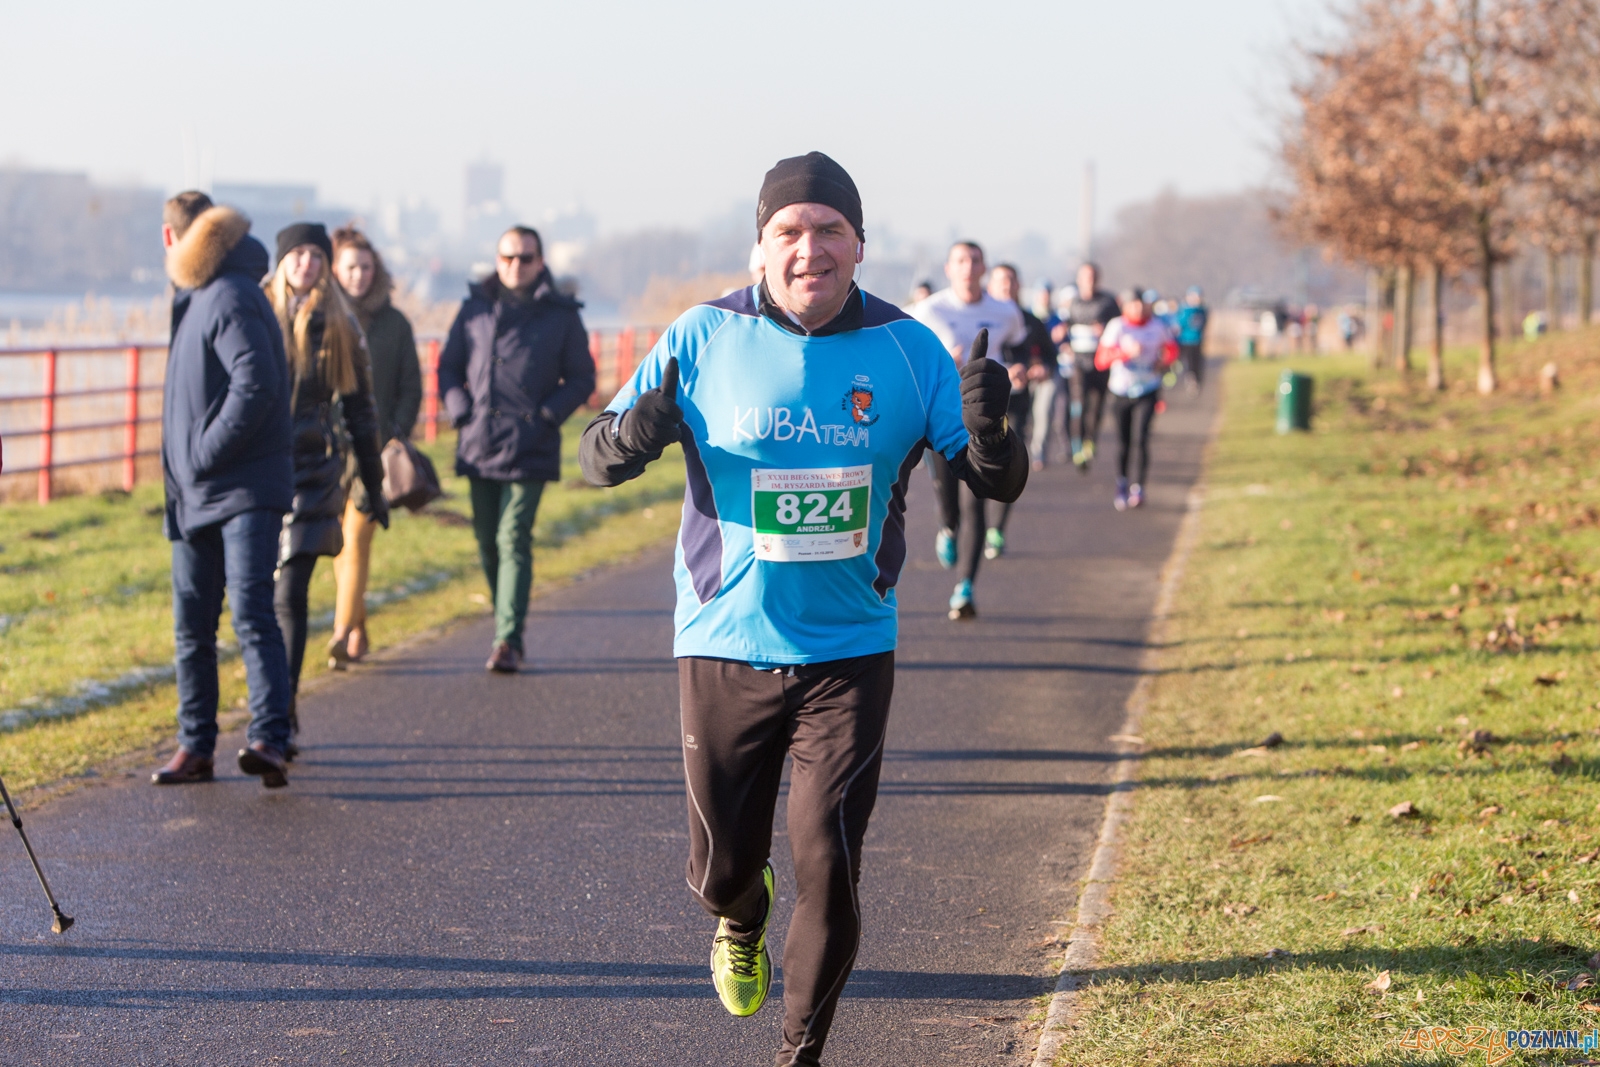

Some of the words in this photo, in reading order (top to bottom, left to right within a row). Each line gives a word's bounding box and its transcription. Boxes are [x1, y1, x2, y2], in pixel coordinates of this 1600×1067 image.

[732, 405, 821, 444] KUBA
[820, 424, 870, 448] TEAM
[811, 470, 865, 480] SYLWESTROWY
[784, 481, 825, 489] RYSZARDA
[827, 479, 862, 488] BURGIELA
[775, 491, 853, 525] 824
[796, 525, 835, 533] ANDRZEJ
